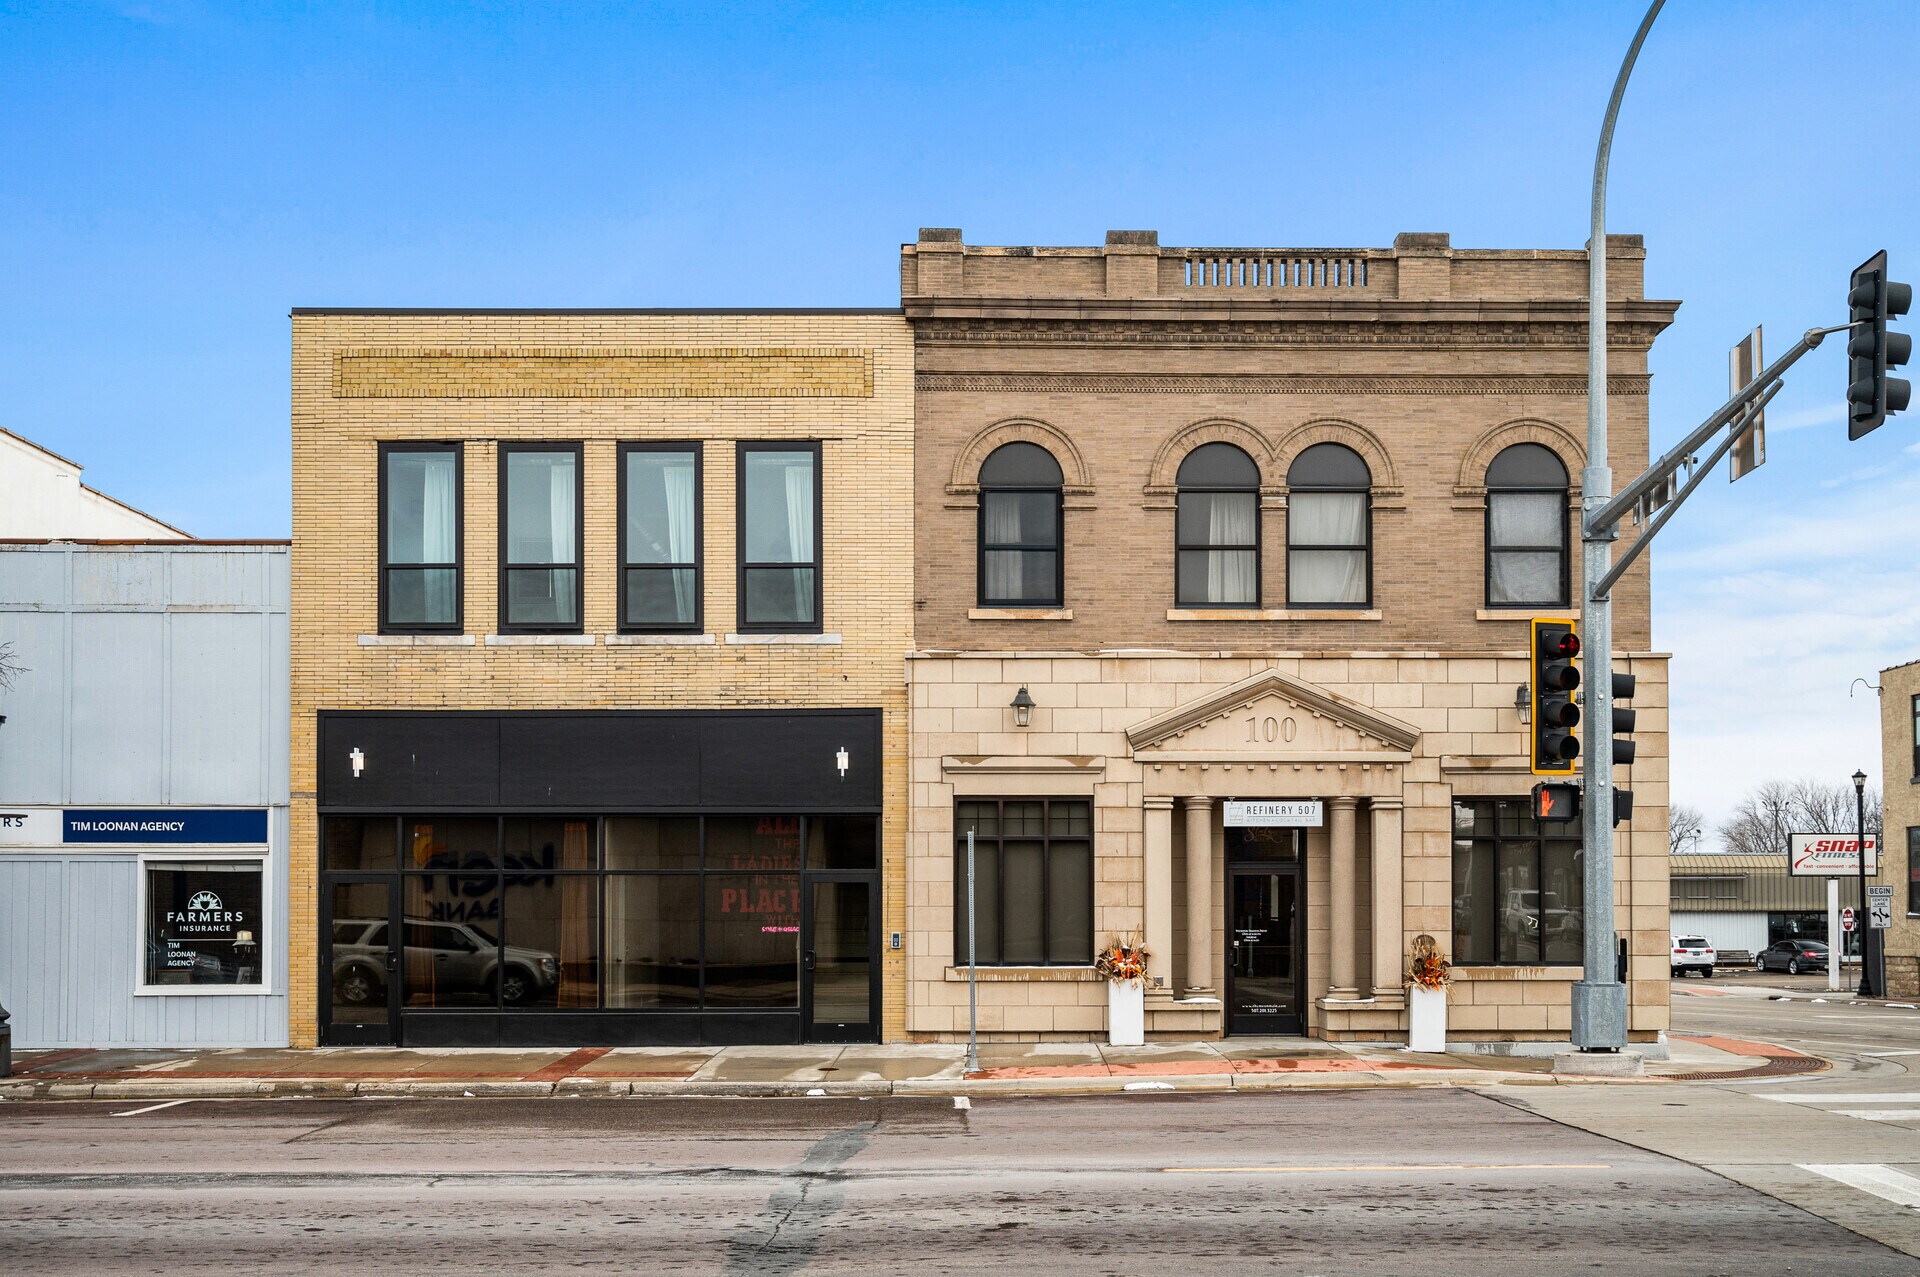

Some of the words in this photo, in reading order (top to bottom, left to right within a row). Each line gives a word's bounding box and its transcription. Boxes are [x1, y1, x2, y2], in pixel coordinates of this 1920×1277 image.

[1245, 716, 1297, 743] 100
[1246, 805, 1293, 815] REFINERY
[1298, 805, 1316, 815] 507
[70, 821, 91, 831] TIM
[92, 821, 139, 831] LOONAN
[140, 821, 185, 831] AGENCY
[1869, 887, 1891, 895] BEGIN
[167, 911, 244, 922] FARMERS
[179, 924, 231, 932] INSURANCE
